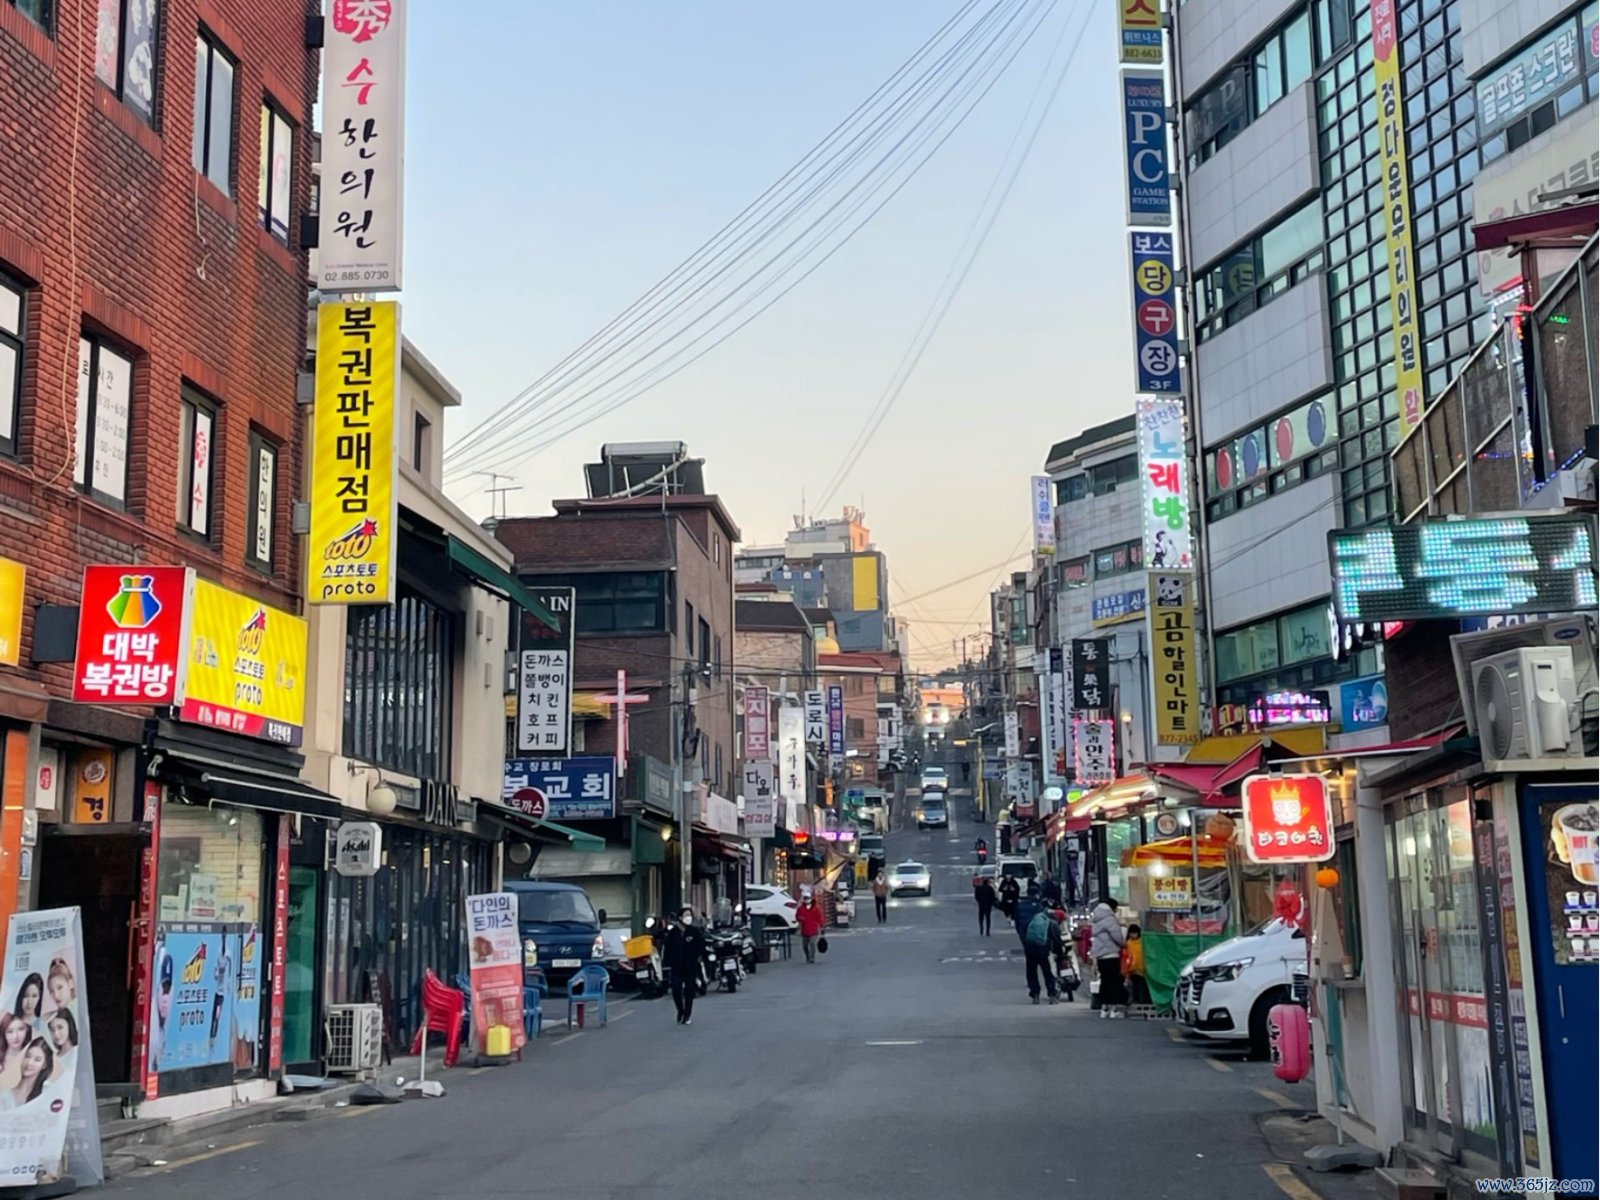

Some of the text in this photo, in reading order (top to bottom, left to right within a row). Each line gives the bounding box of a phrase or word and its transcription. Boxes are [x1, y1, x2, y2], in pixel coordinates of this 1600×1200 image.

[1131, 111, 1163, 183] PC
[1132, 197, 1168, 206] STATION
[1133, 188, 1166, 197] GAME
[1380, 78, 1416, 373] 정다운우리의원
[1134, 235, 1171, 254] 보스
[1144, 266, 1171, 372] 당구장
[1150, 380, 1172, 390] 3F
[335, 306, 377, 513] 복권판매점
[1147, 430, 1186, 530] 노래방
[321, 563, 377, 578] 스포츠토토
[322, 580, 376, 599] proto
[102, 632, 159, 662] 대박
[524, 654, 565, 668] 돈까스
[82, 663, 174, 697] 복권방
[234, 682, 263, 706] proto
[528, 693, 559, 707] 치킨
[527, 712, 558, 727] 호프
[807, 693, 824, 740] 도로시
[526, 733, 558, 746] 커피
[425, 778, 459, 827] DAIN
[1153, 878, 1188, 891] 붕어빵
[178, 1010, 206, 1031] proto
